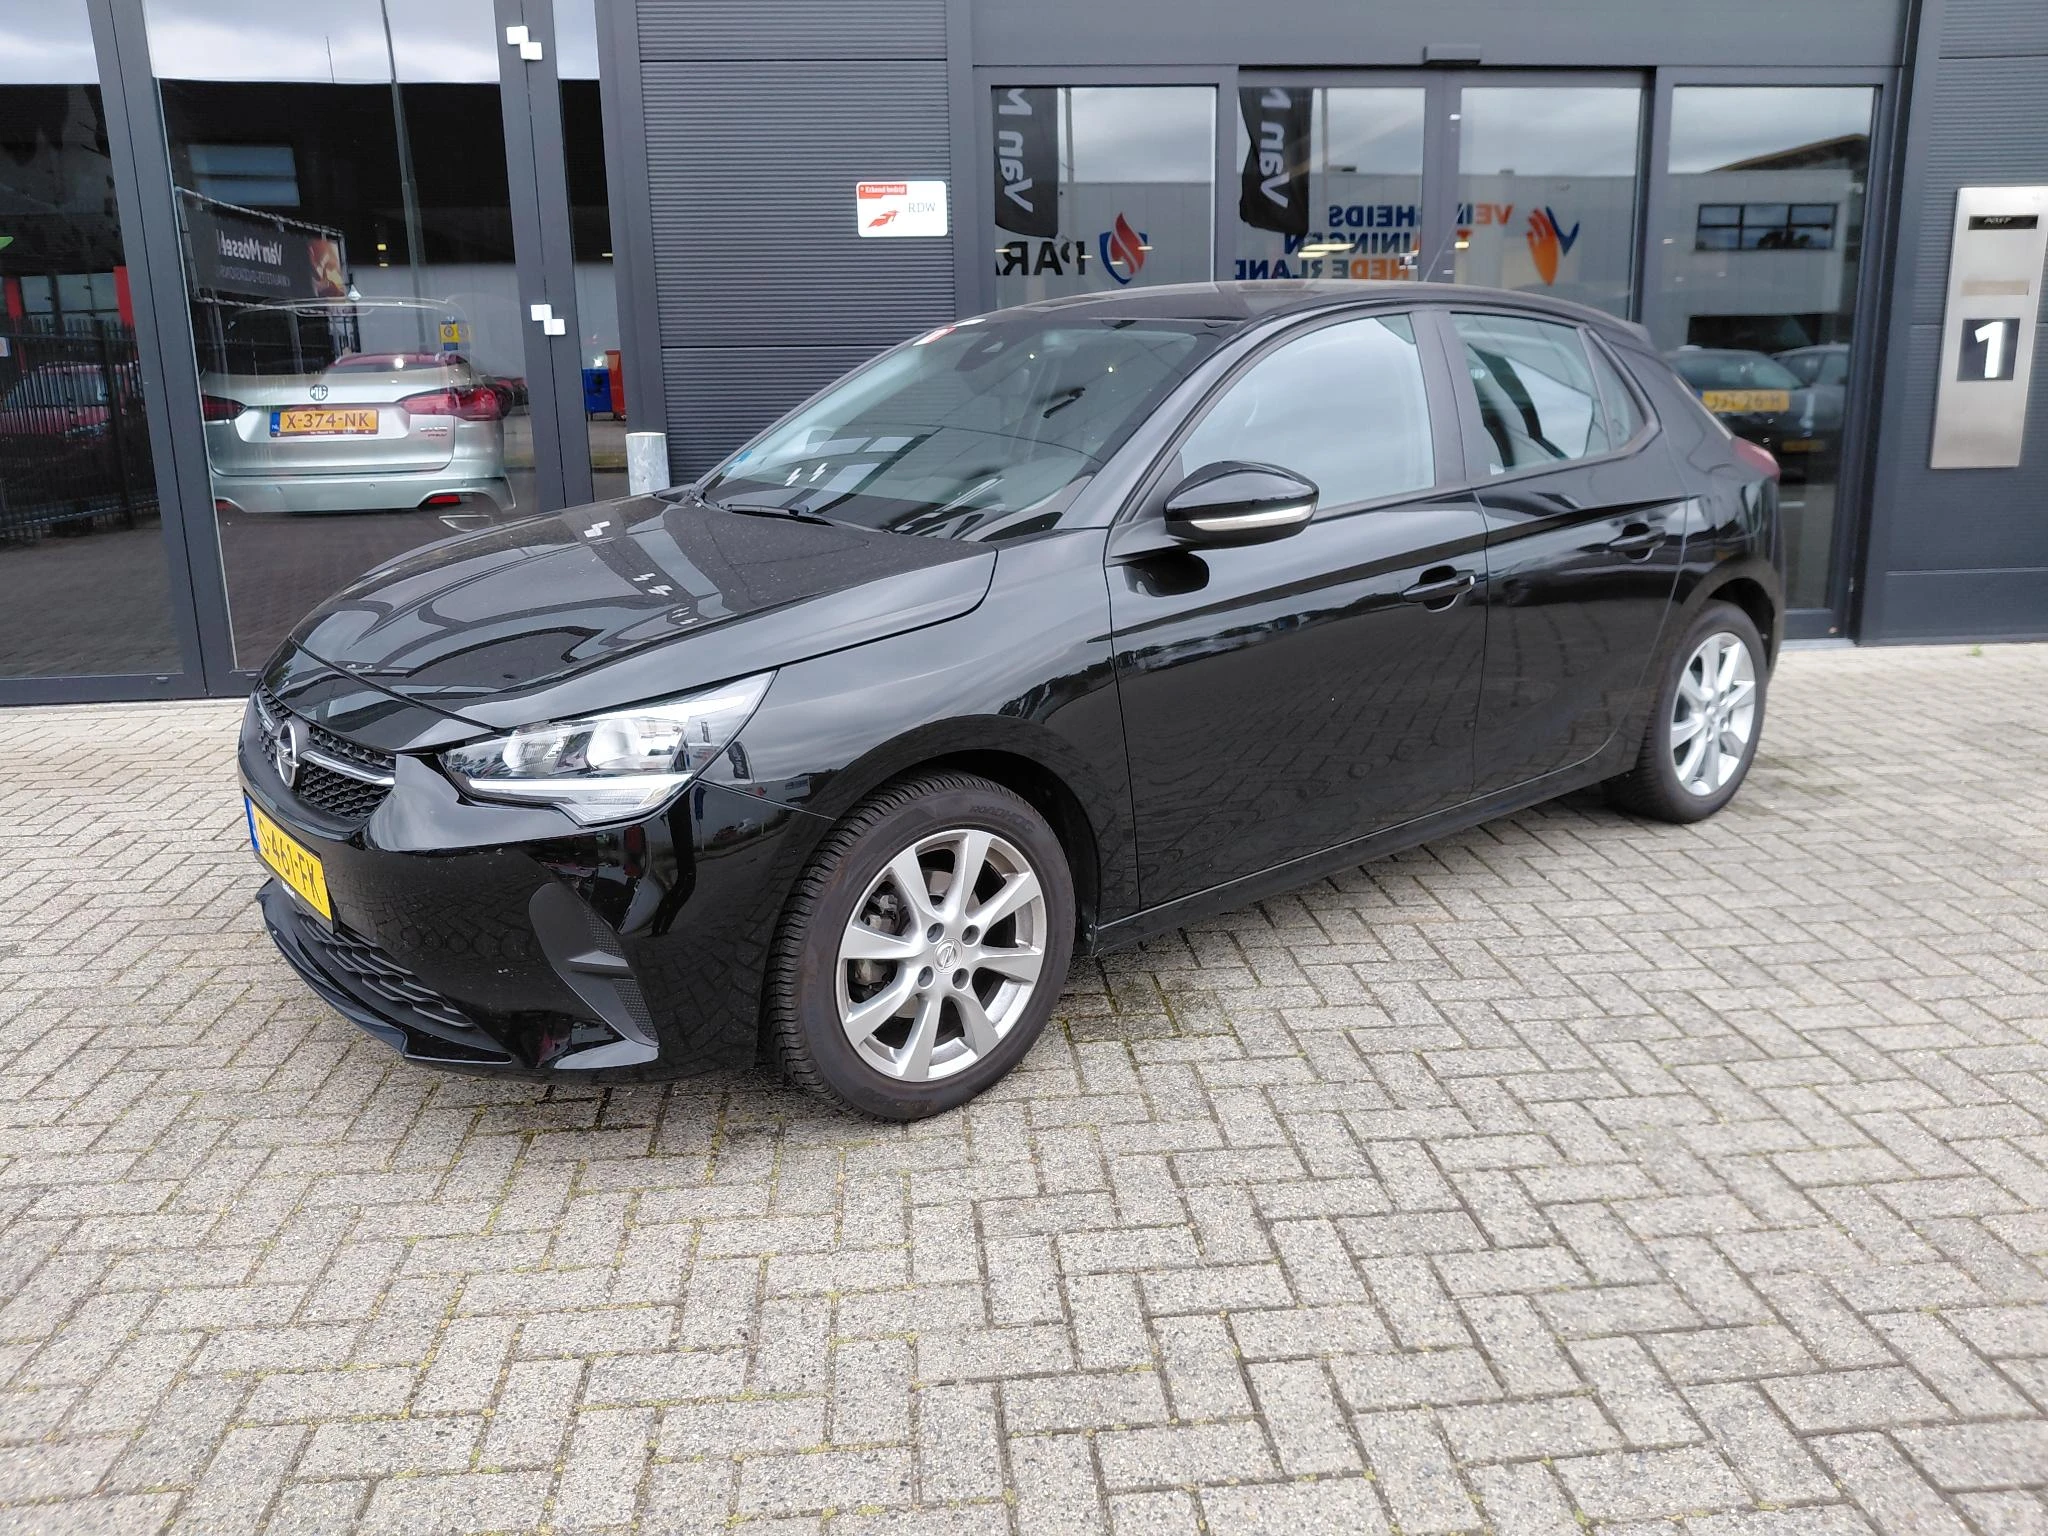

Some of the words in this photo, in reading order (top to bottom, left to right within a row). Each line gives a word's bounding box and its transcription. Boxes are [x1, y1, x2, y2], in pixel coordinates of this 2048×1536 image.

[908, 202, 936, 213] RDW
[1974, 321, 2005, 379] 1
[286, 413, 370, 429] X-374-NK
[258, 816, 322, 906] S-461-FK
